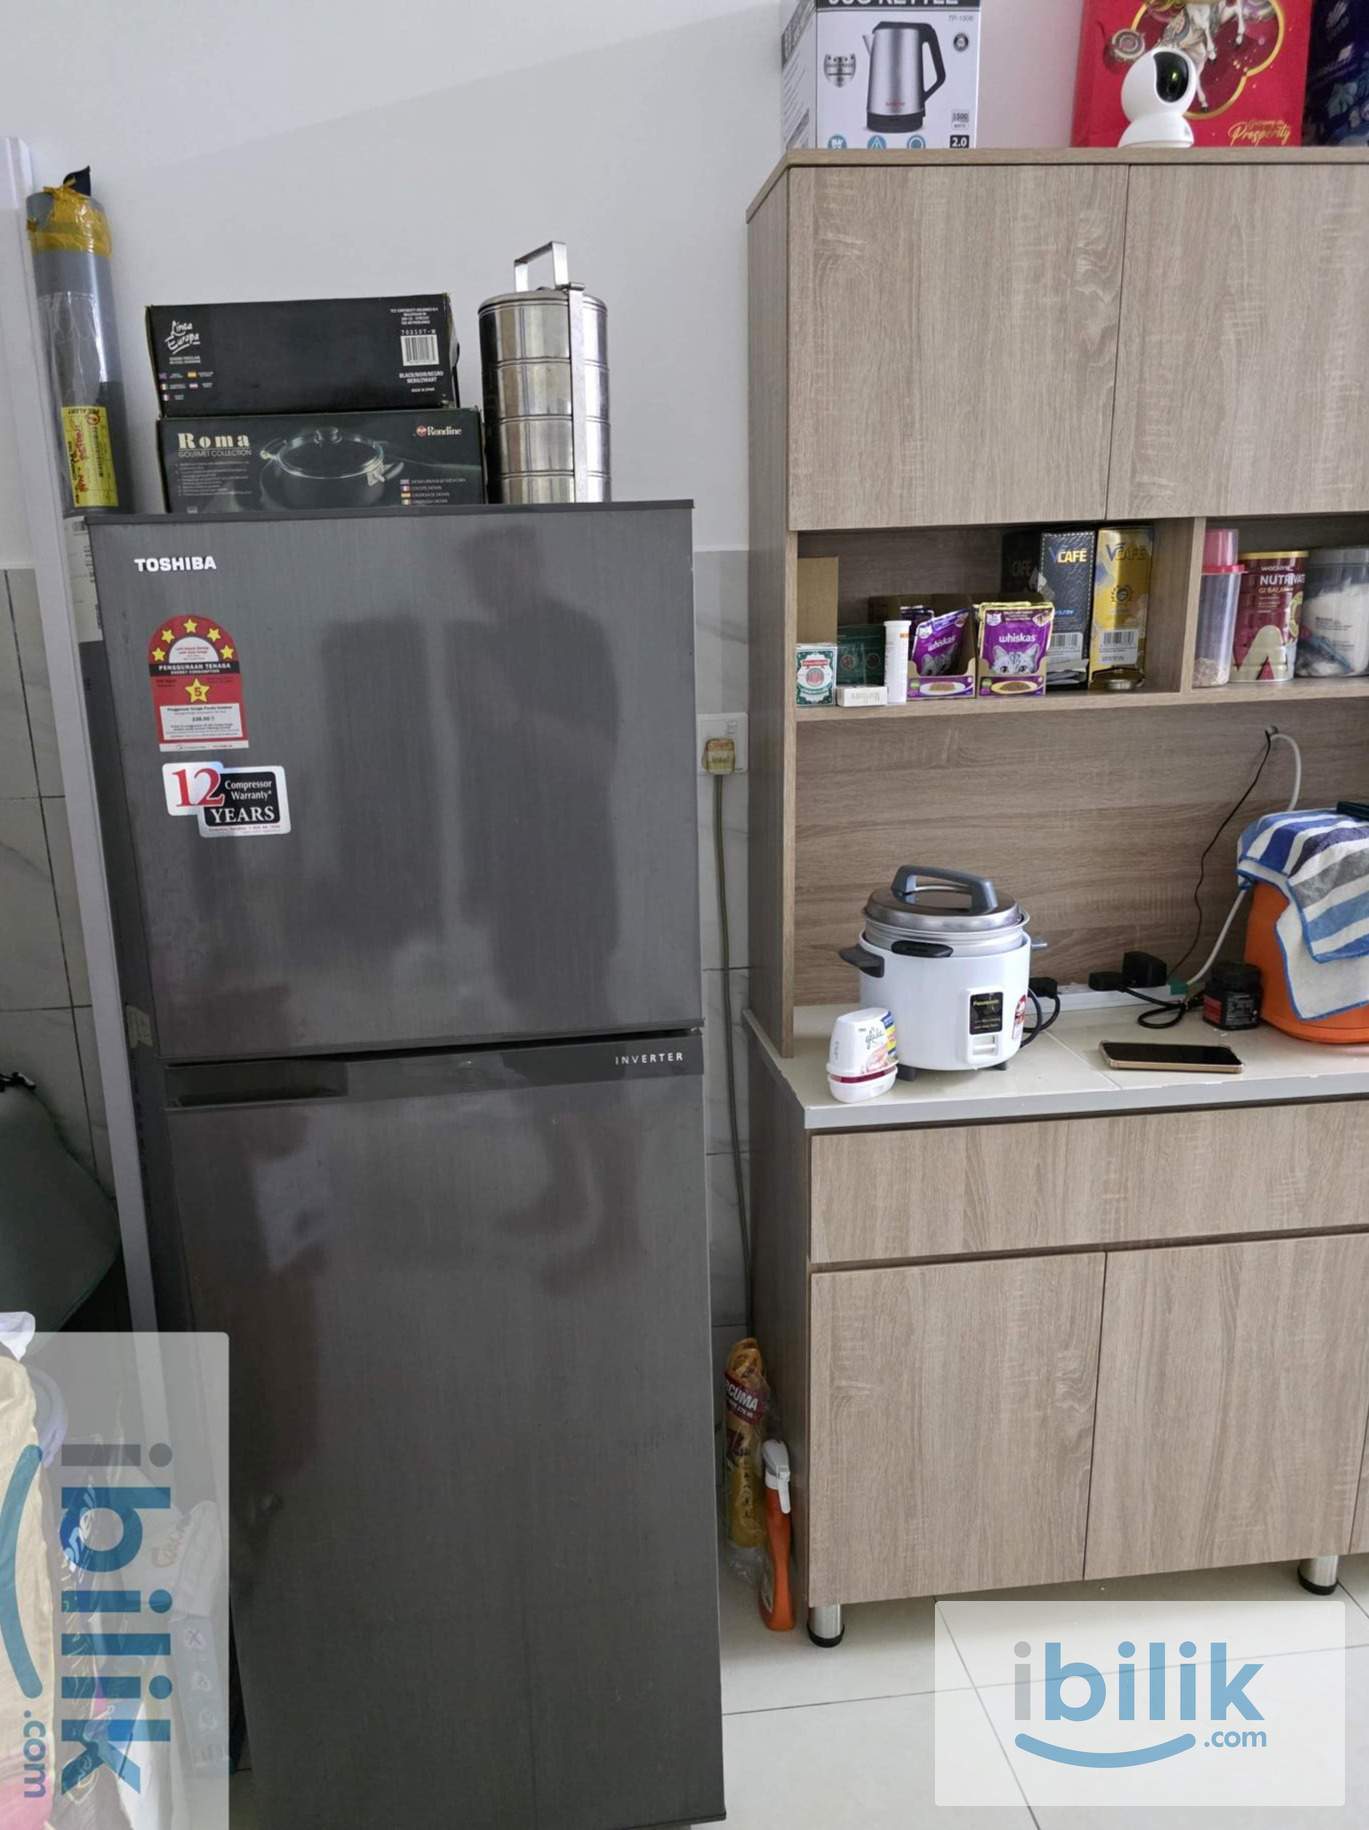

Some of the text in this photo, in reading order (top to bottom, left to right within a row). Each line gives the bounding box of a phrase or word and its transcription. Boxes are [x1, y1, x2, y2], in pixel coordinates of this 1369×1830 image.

[951, 136, 968, 148] 2.0
[177, 432, 250, 449] Roma
[211, 449, 252, 457] COLLECTION
[134, 555, 217, 572] TOSHIBA
[998, 632, 1037, 644] whiskas
[171, 767, 225, 808] 12
[224, 780, 272, 791] Compressor
[210, 805, 276, 824] YEARS
[615, 1051, 684, 1065] INVERTER
